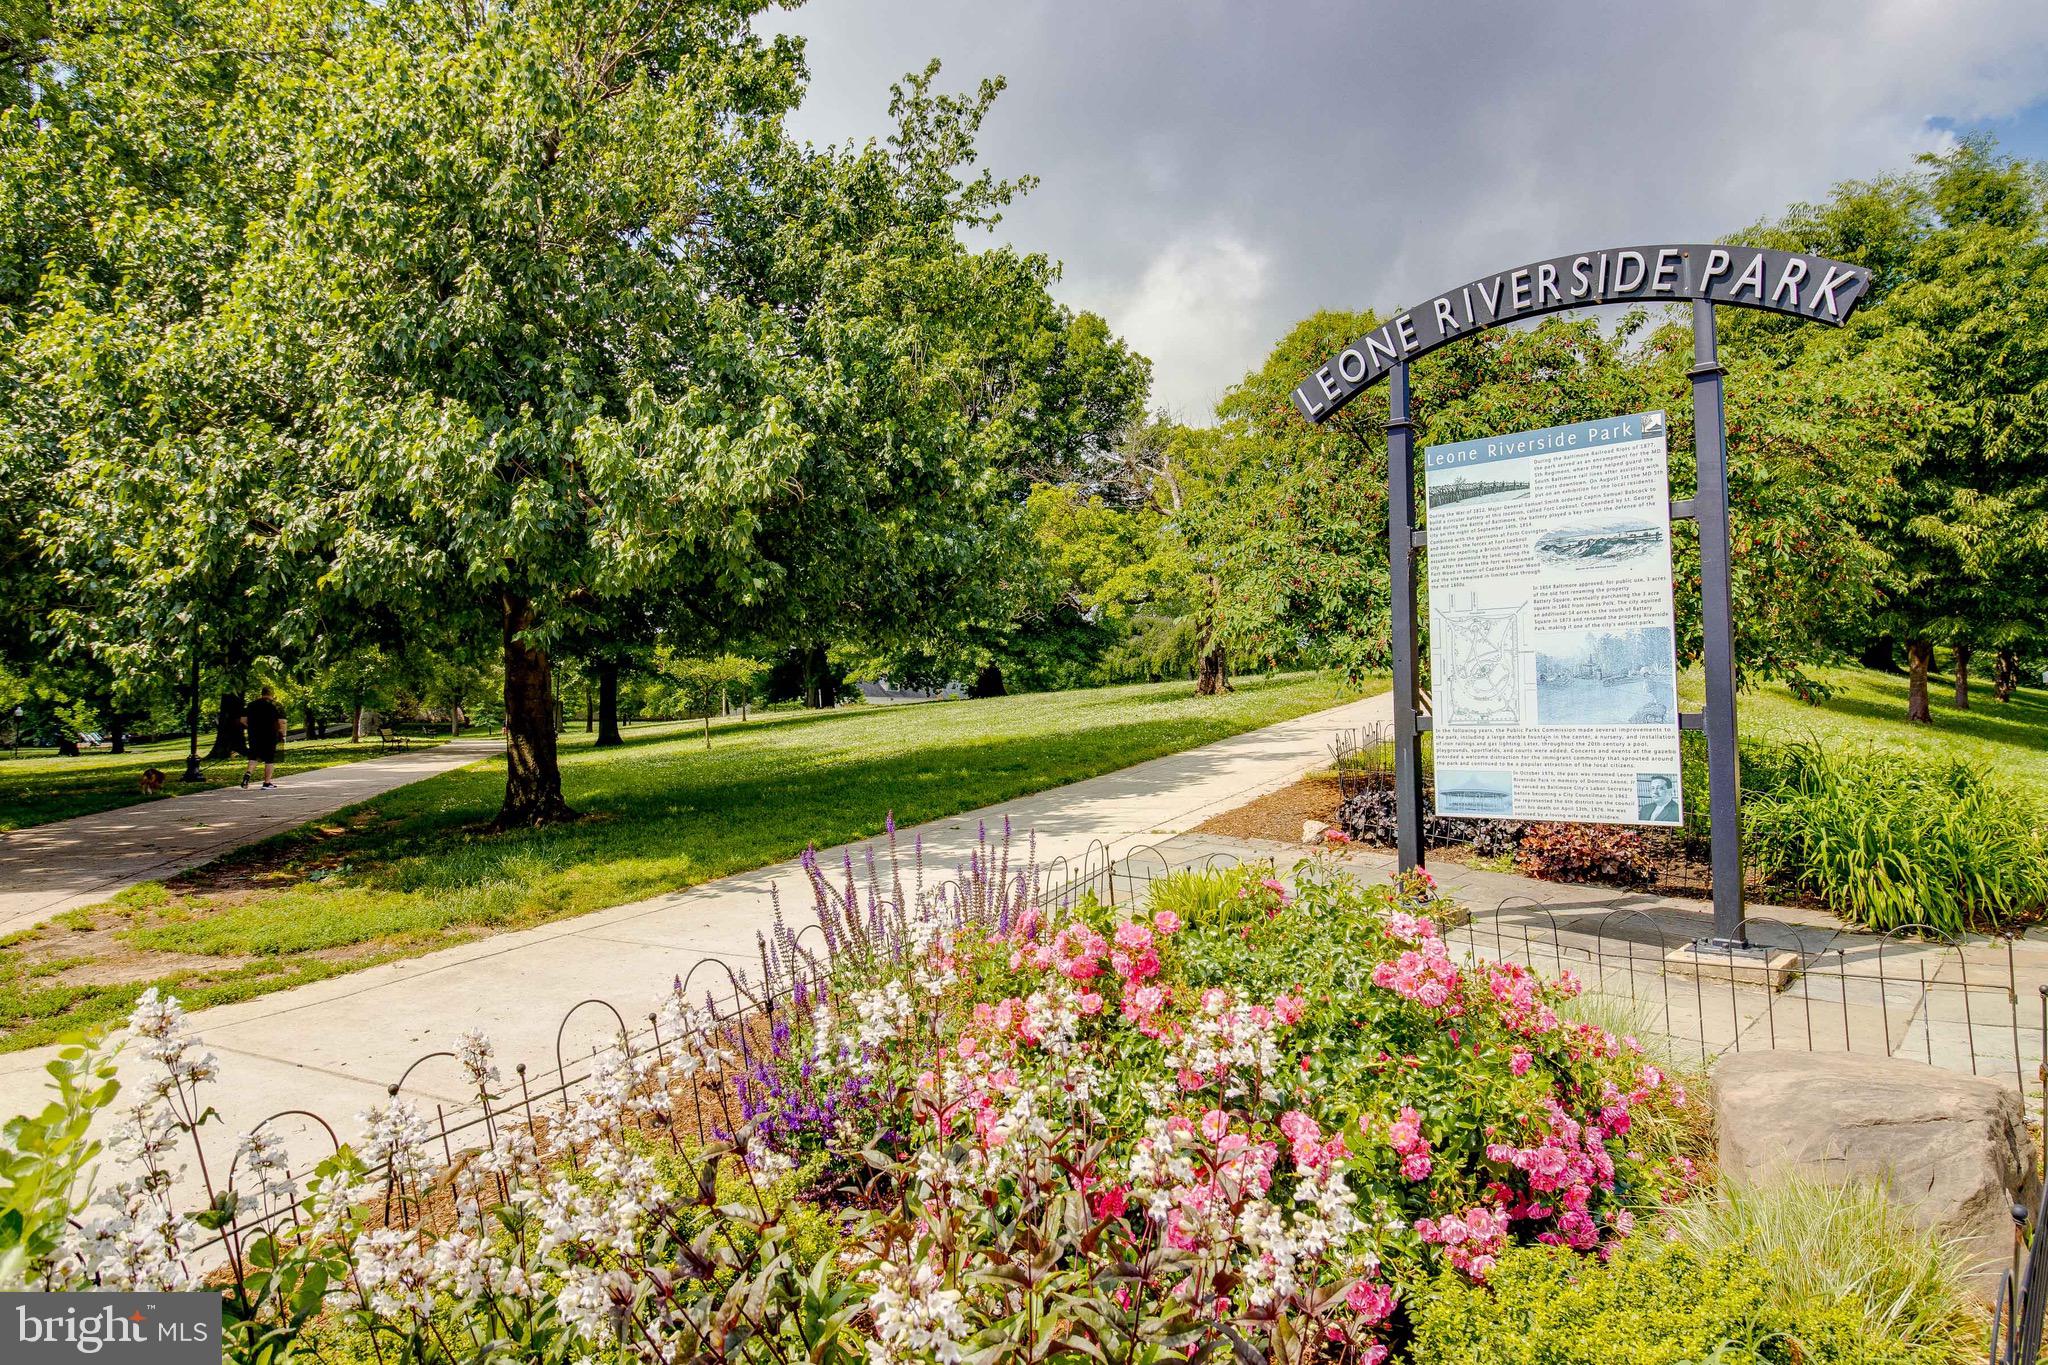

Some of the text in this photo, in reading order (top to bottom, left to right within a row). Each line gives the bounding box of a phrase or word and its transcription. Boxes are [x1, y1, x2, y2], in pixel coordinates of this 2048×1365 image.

[1297, 249, 1856, 416] LEONE RIVERSIDE PARK
[1427, 422, 1633, 466] Leone Riverside Park
